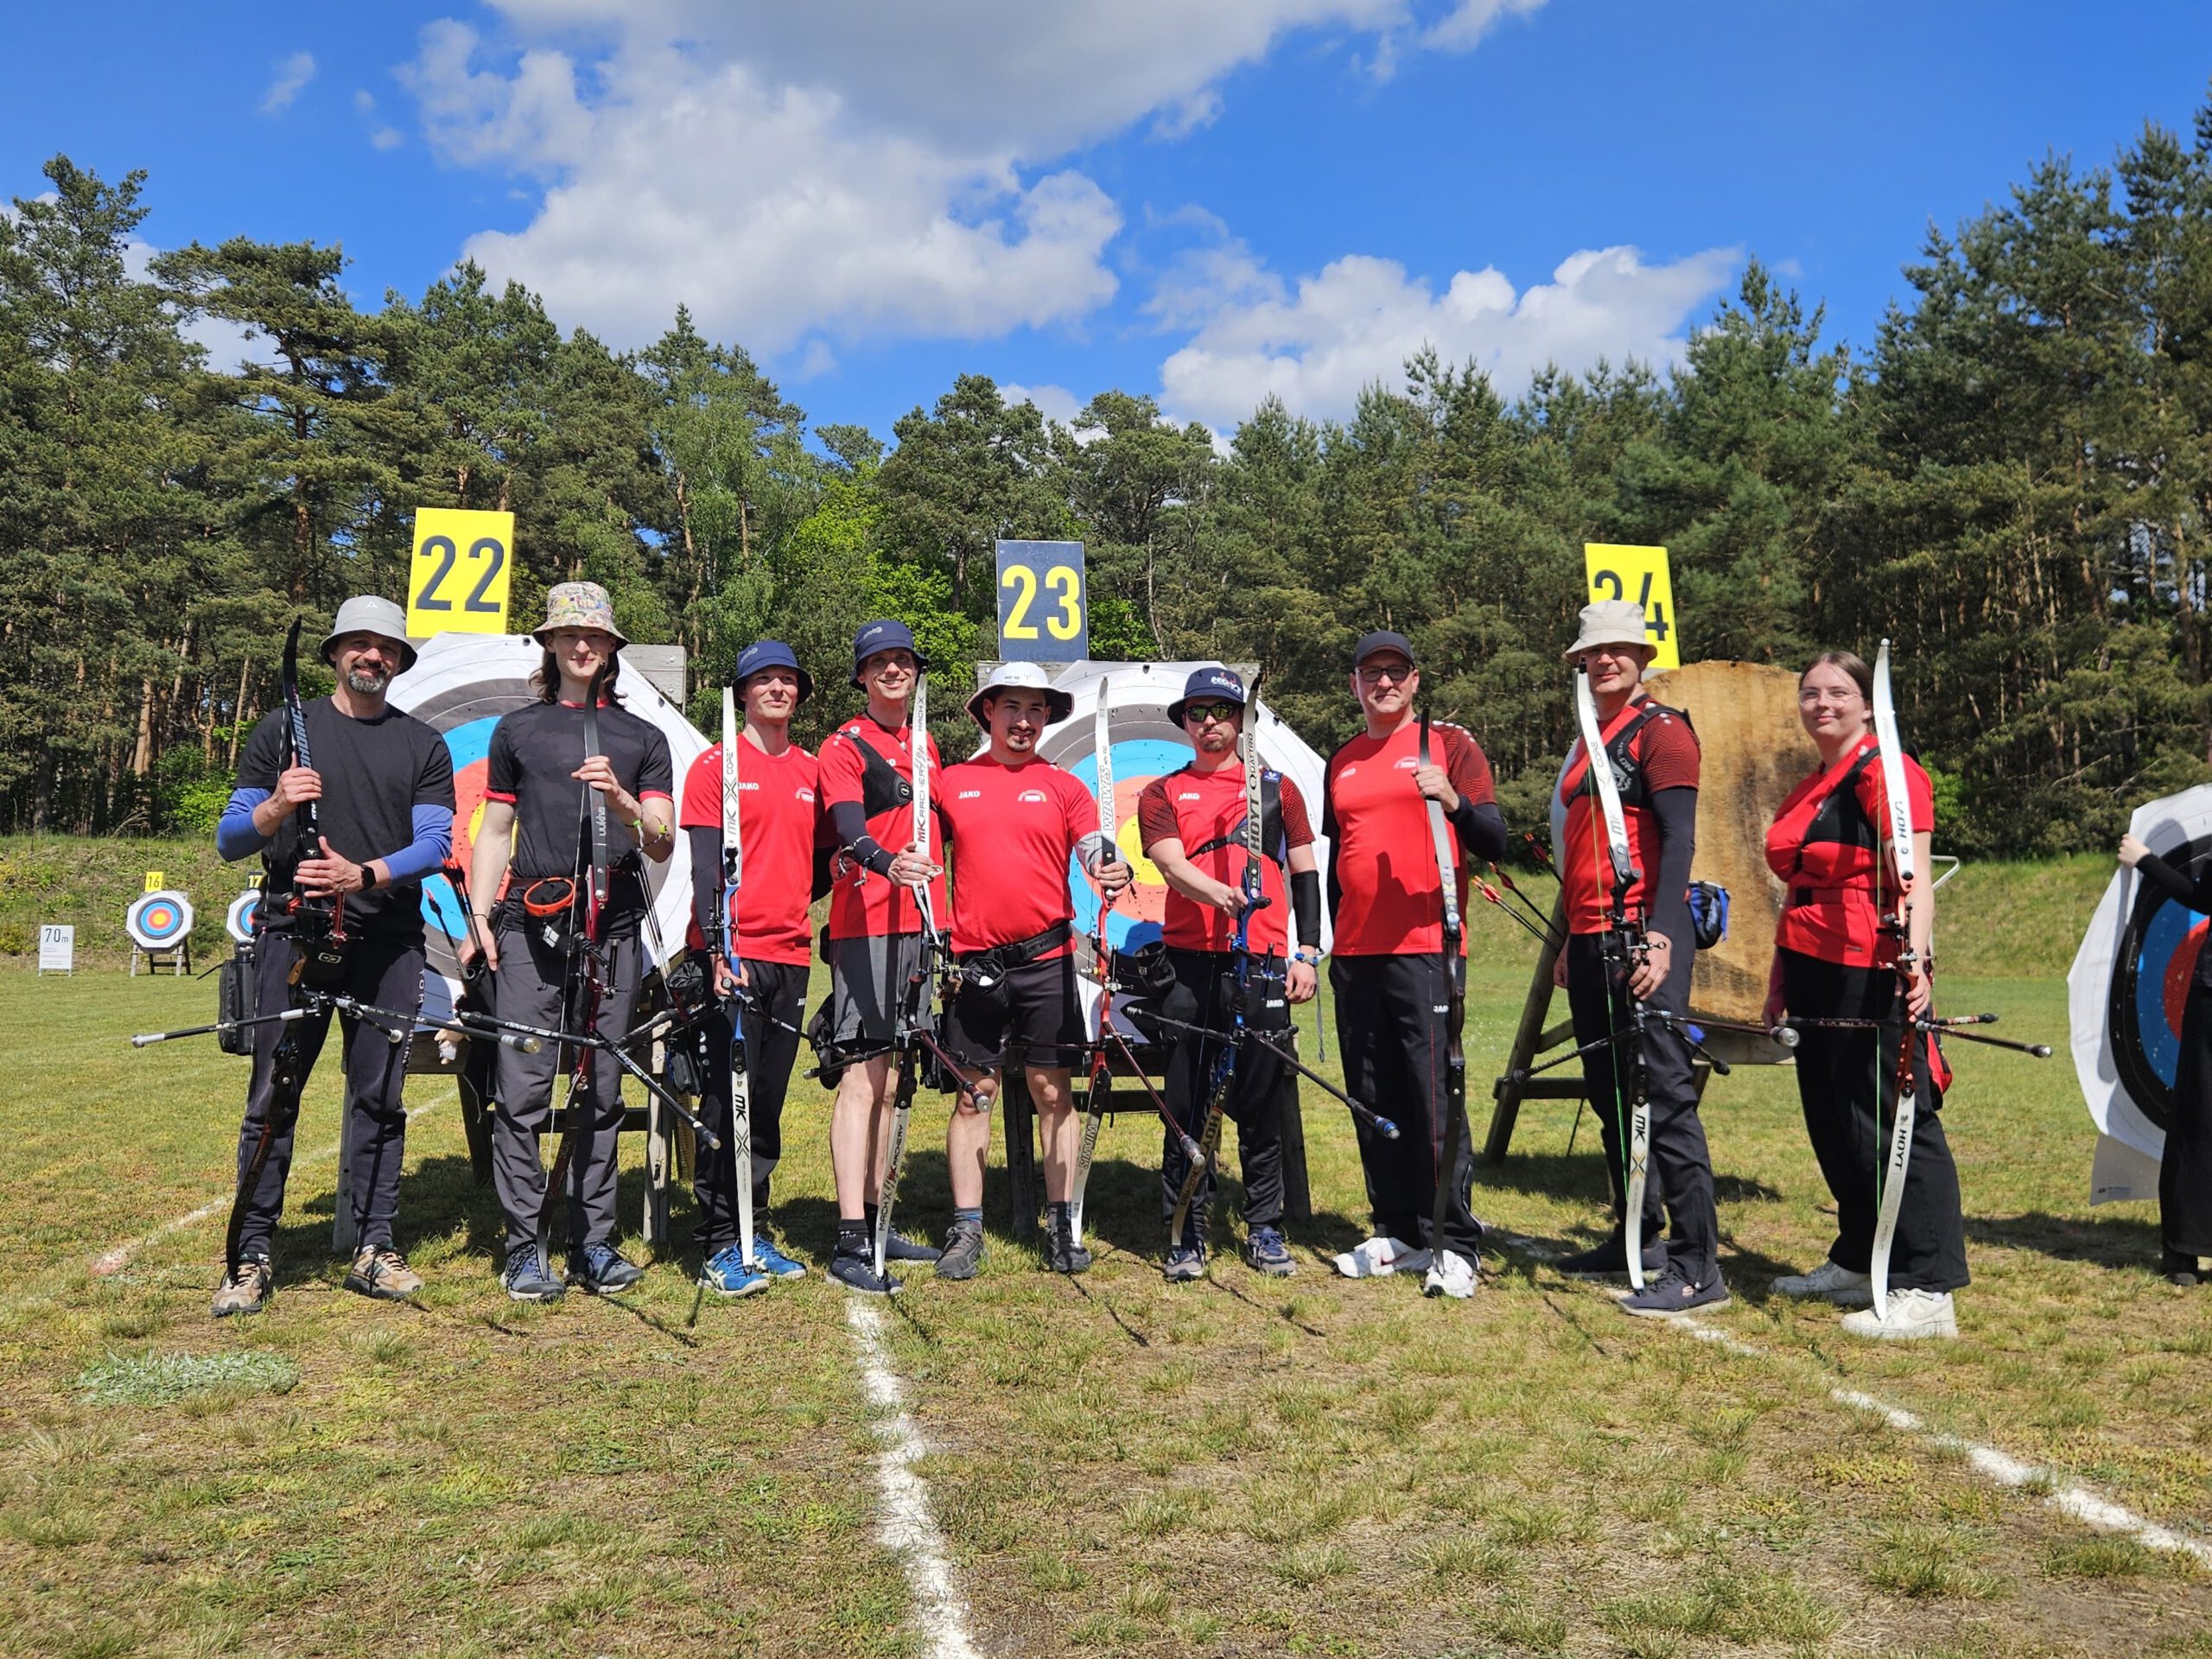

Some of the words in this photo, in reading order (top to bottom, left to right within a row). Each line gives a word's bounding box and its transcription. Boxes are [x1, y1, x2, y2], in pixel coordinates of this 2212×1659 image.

[416, 535, 505, 613] 22
[1001, 564, 1082, 641] 23
[290, 706, 312, 769] ONORIC
[738, 782, 760, 791] JAKO
[957, 790, 981, 799] JAKO
[1178, 792, 1200, 801] JAKO
[1249, 794, 1260, 850] HOYT
[148, 875, 160, 888] 16
[248, 874, 263, 888] 17
[734, 1094, 747, 1122] MK
[1201, 1115, 1219, 1157] HOY
[1635, 1114, 1645, 1142] MK
[1895, 1129, 1907, 1171] HOYT
[879, 1202, 888, 1231] MACH
